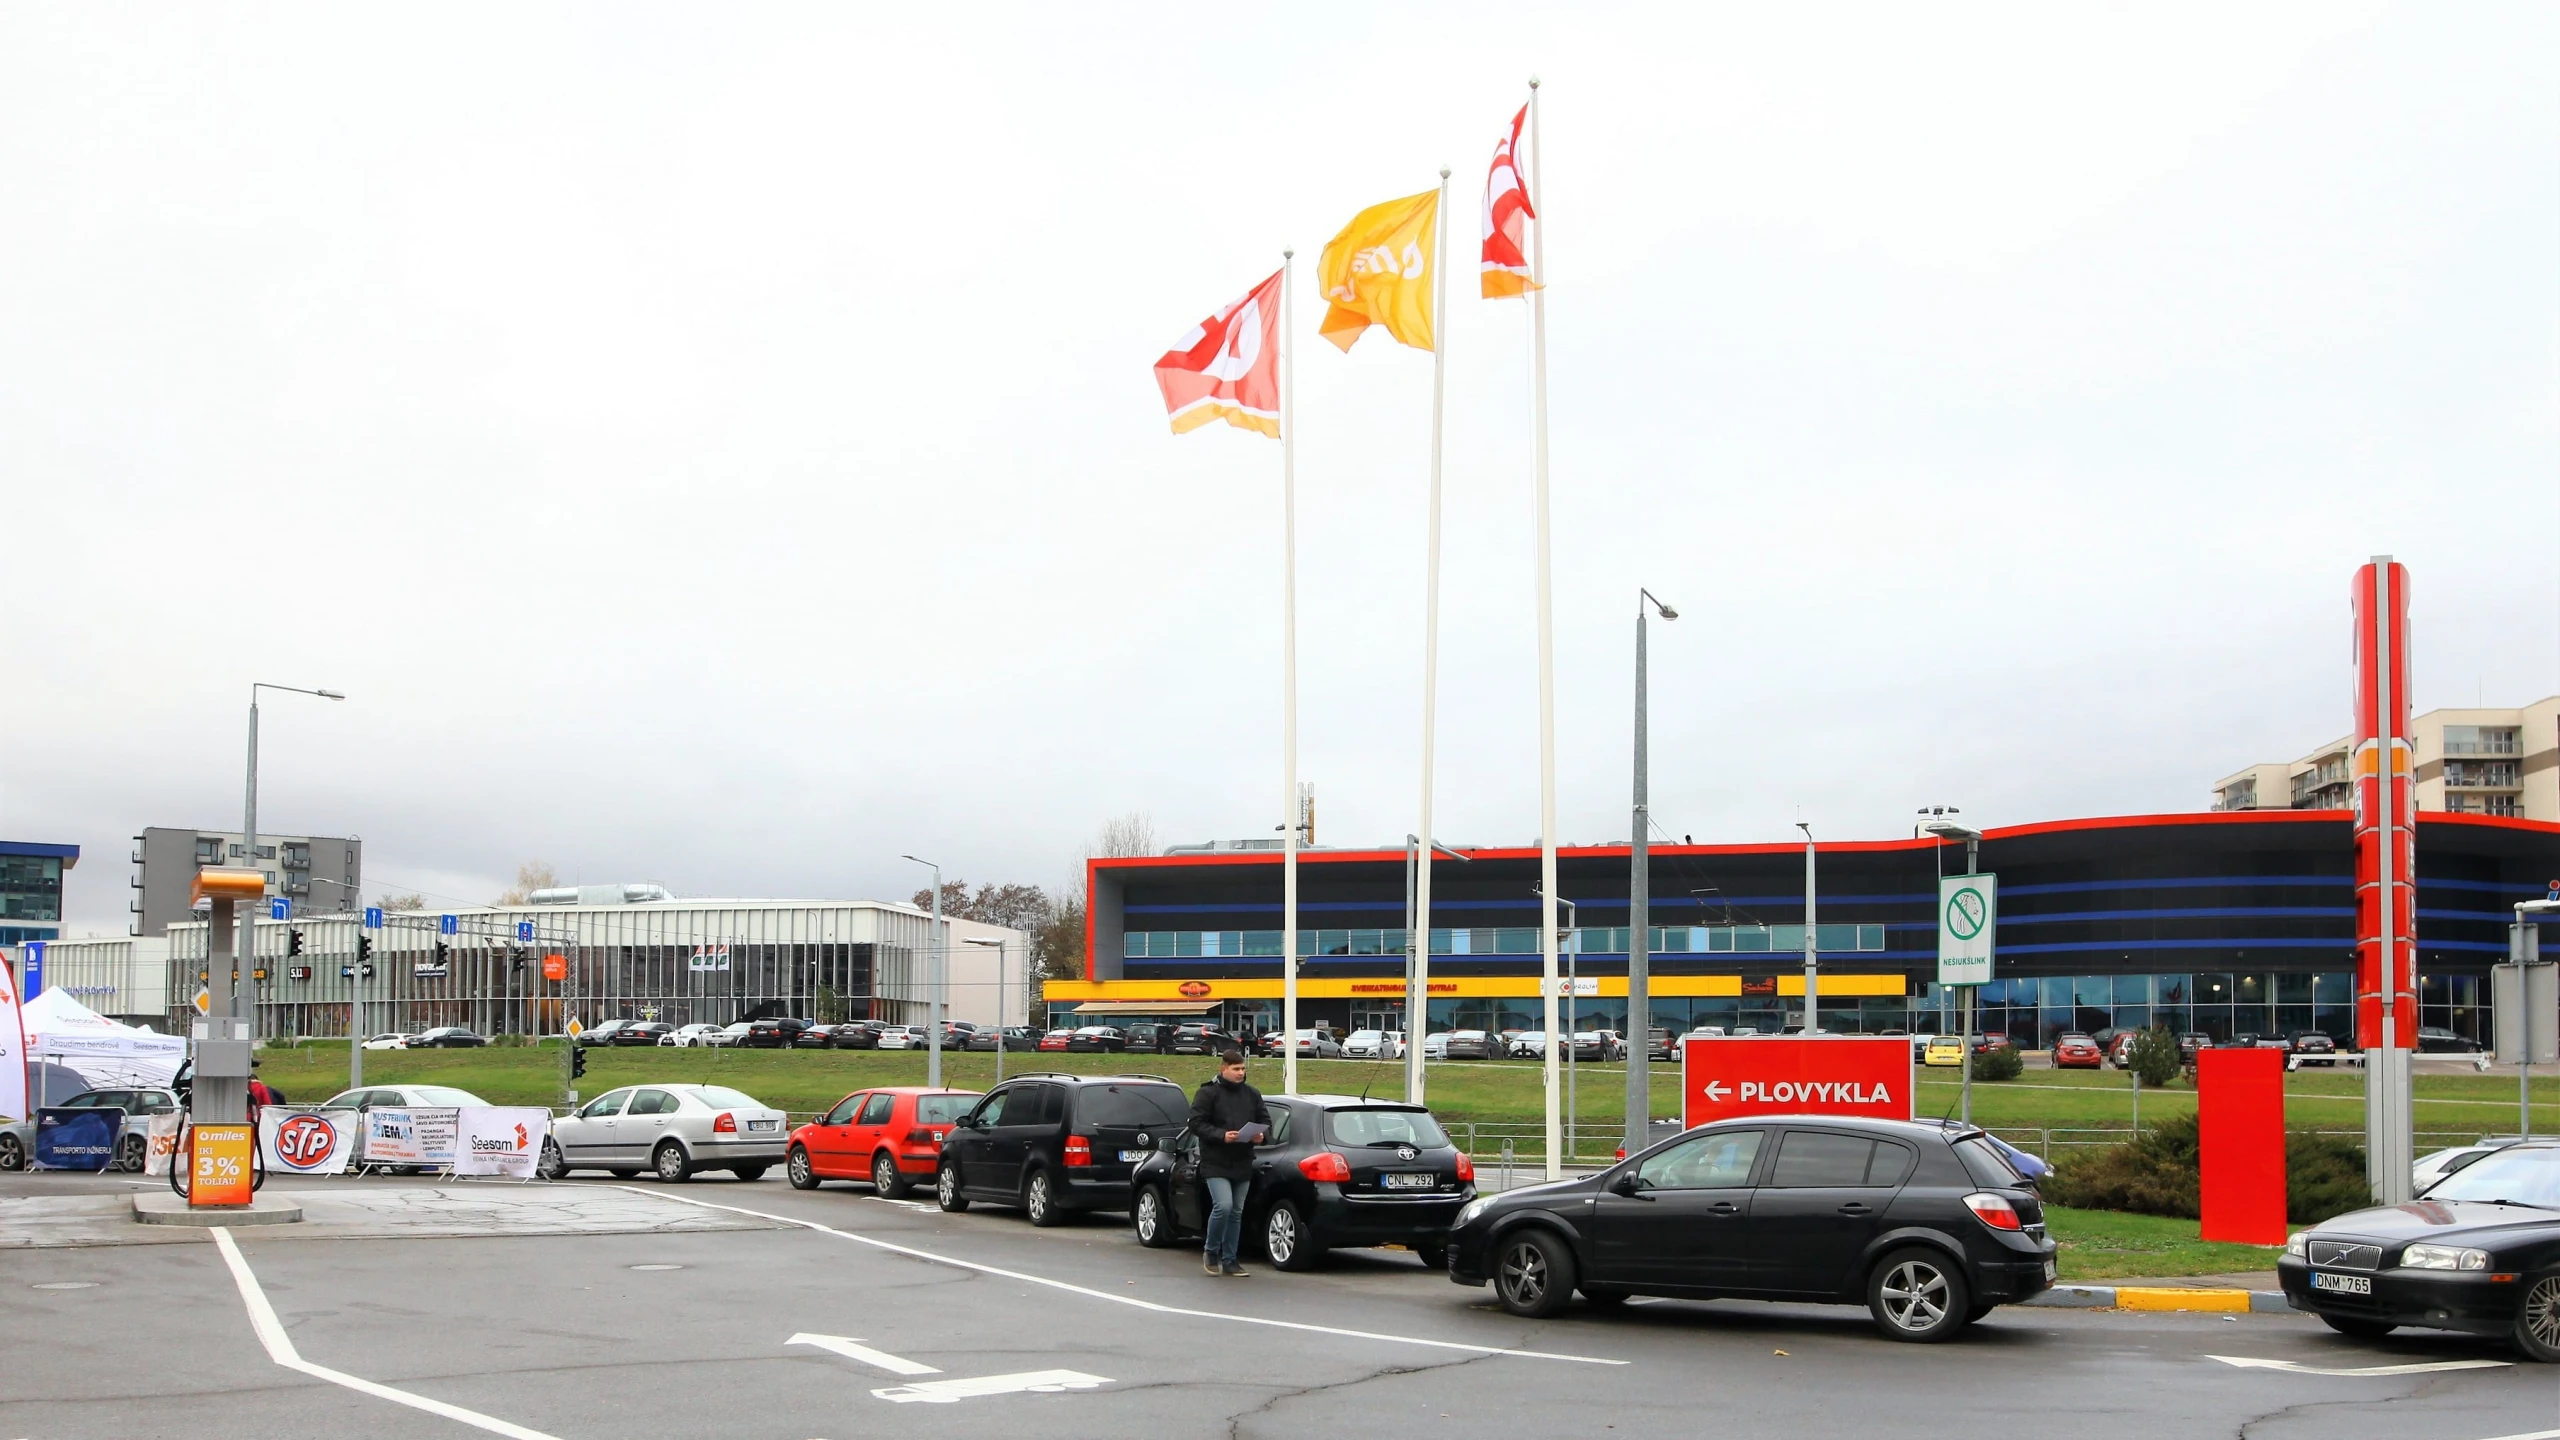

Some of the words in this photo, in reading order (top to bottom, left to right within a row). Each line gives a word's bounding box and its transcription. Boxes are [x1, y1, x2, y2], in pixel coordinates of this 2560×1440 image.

[1943, 956, 1986, 966] NEŠIUKŠLINK
[50, 1038, 86, 1048] Draudimo
[1740, 1081, 1891, 1103] PLOVYKLA
[210, 1130, 246, 1142] miles
[281, 1121, 329, 1160] STP
[472, 1134, 512, 1152] Seesam
[52, 1146, 86, 1154] TRANSPORTO
[199, 1147, 213, 1155] IKI
[198, 1177, 236, 1186] TOLIAU
[1388, 1174, 1408, 1185] CNL
[1414, 1174, 1432, 1185] 292
[2316, 1274, 2340, 1289] DNM
[2348, 1278, 2369, 1292] 765
